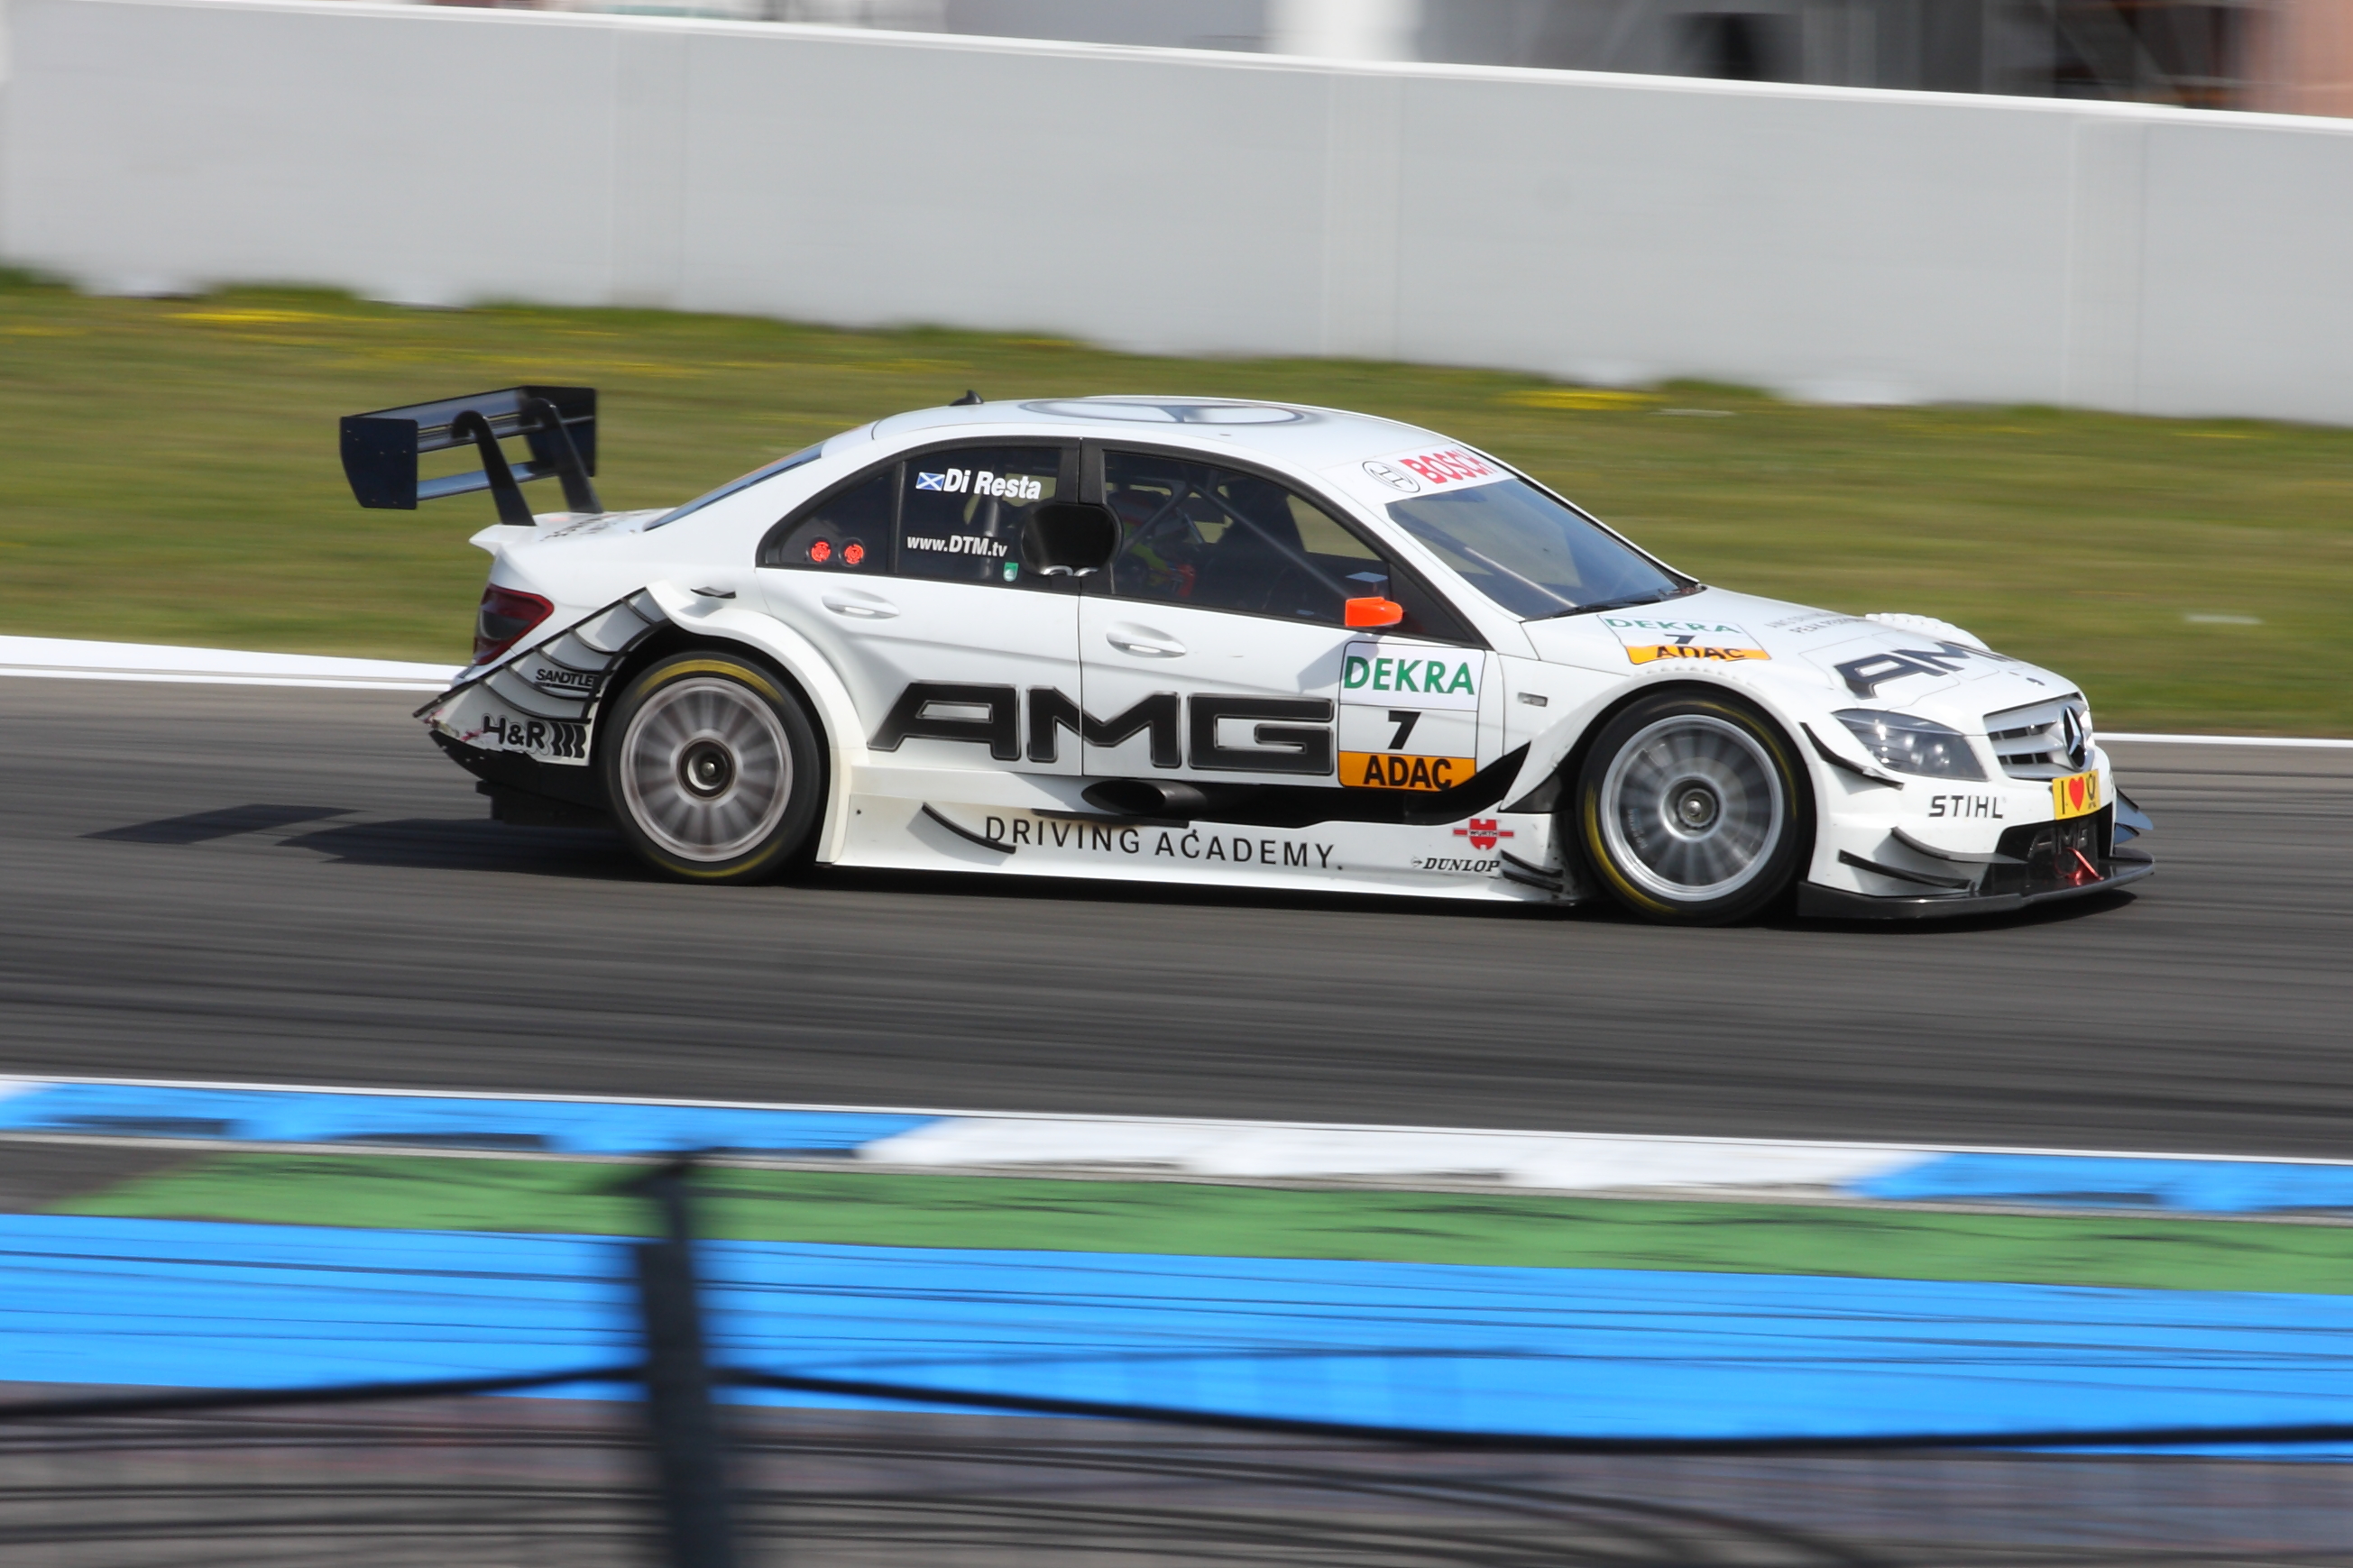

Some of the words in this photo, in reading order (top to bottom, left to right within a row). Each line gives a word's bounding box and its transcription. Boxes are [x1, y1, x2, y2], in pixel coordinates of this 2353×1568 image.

[1398, 449, 1498, 484] BOSCH
[942, 468, 971, 493] Di
[973, 471, 1042, 500] Resta
[906, 535, 1007, 557] www.DTM.tv
[1604, 619, 1742, 633] DEKRA
[1664, 633, 1696, 645] 7
[1656, 646, 1745, 659] ADAC
[1343, 656, 1475, 695] DEKRA
[1833, 640, 2017, 700] AM
[483, 715, 546, 749] H&R
[867, 680, 1335, 775] AMG
[1387, 710, 1421, 750] 7
[1363, 755, 1453, 791] ADAC
[1928, 795, 2004, 819] STIHL
[985, 816, 1141, 854] DRIVING
[1423, 857, 1501, 874] DUNLOP
